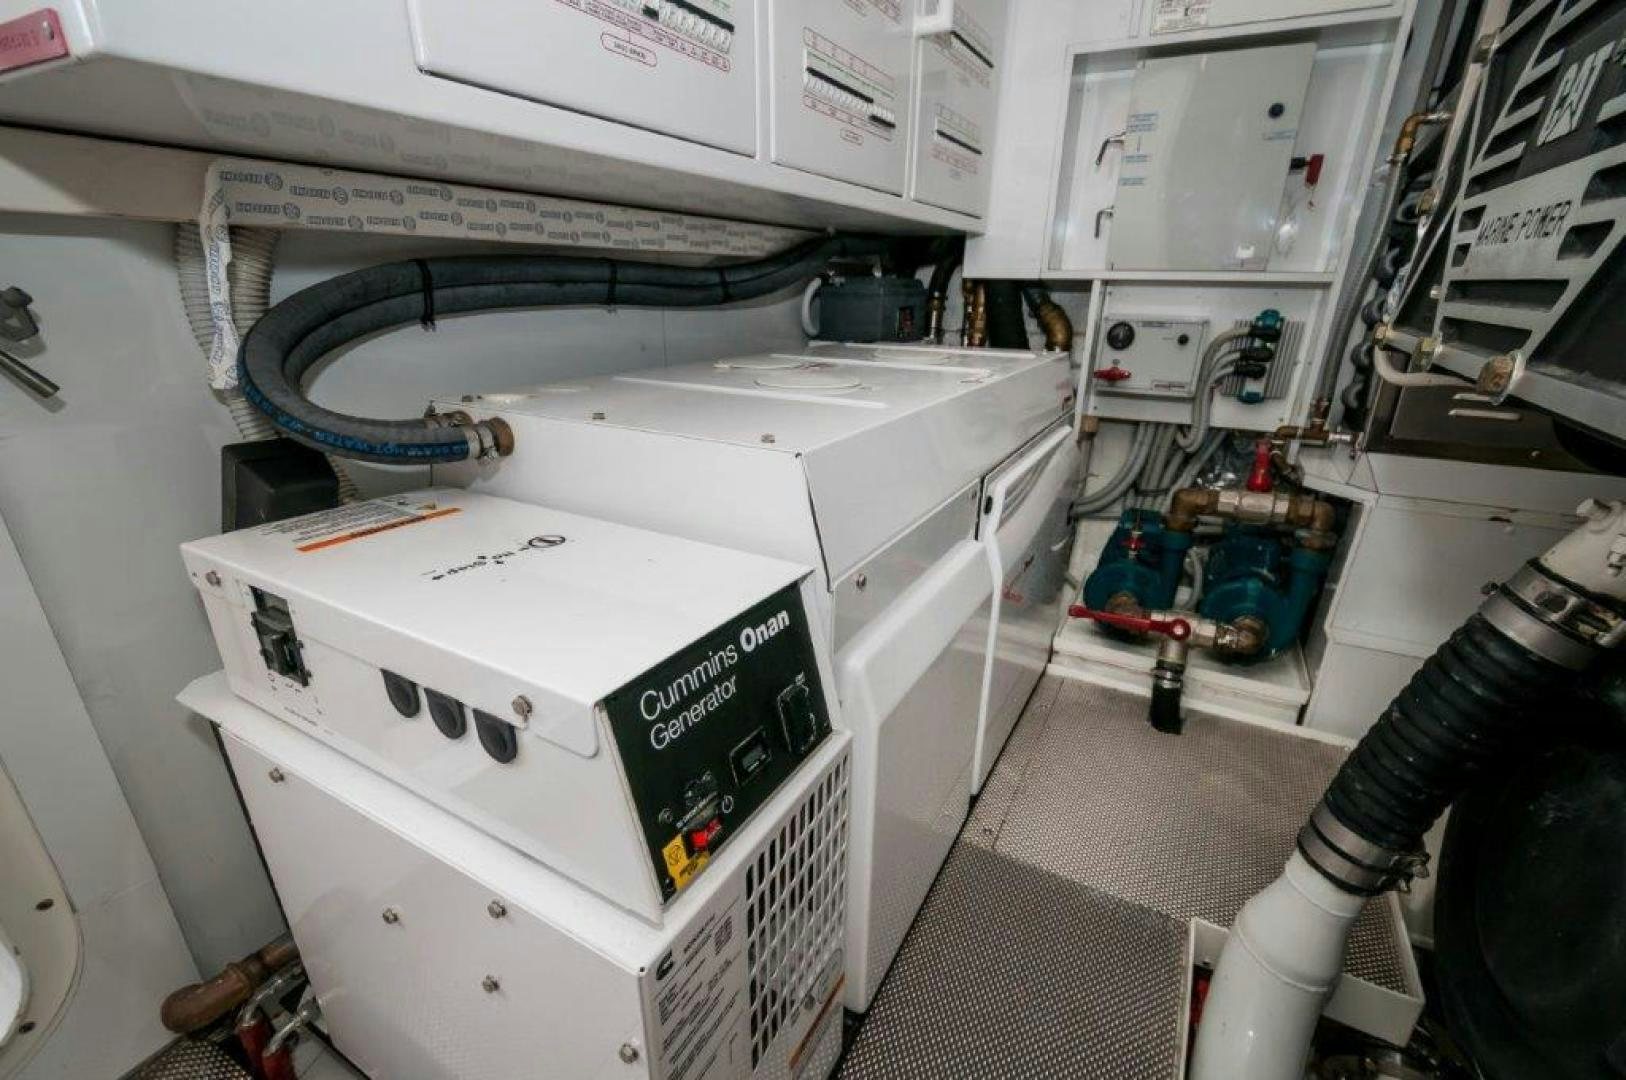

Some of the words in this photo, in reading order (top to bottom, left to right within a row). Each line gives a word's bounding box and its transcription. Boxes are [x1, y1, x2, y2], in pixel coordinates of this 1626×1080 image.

[1537, 41, 1616, 146] CAT
[1477, 212, 1520, 244] MARINE
[1514, 200, 1573, 242] POWER
[640, 644, 738, 720] Cummins
[740, 609, 790, 652] Onan
[650, 675, 738, 749] Generator
